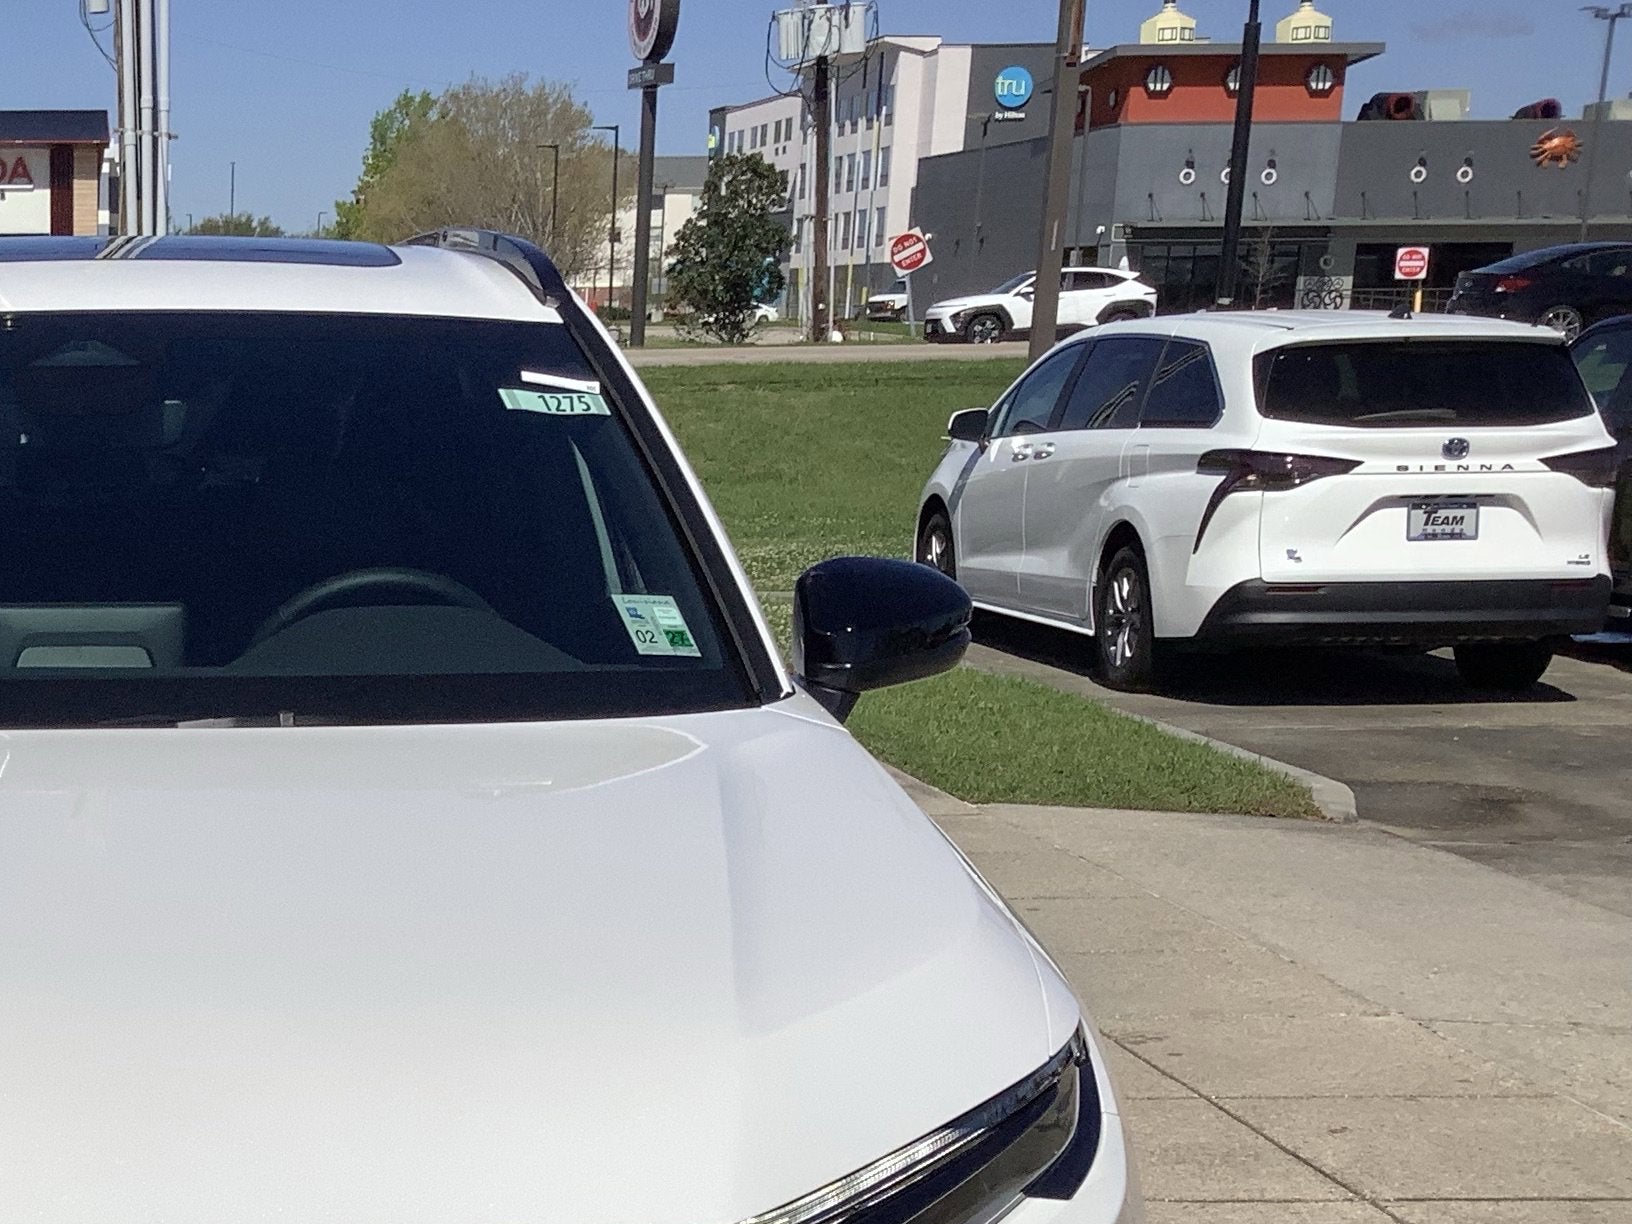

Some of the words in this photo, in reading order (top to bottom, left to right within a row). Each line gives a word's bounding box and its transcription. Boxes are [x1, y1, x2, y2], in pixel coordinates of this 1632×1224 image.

[996, 76, 1025, 96] tru
[995, 112, 1003, 120] by
[893, 243, 903, 254] DO
[903, 236, 918, 247] NOT
[901, 252, 922, 267] ENTER
[537, 394, 591, 412] 1275
[1396, 463, 1515, 472] SIENNA
[635, 629, 658, 644] 02
